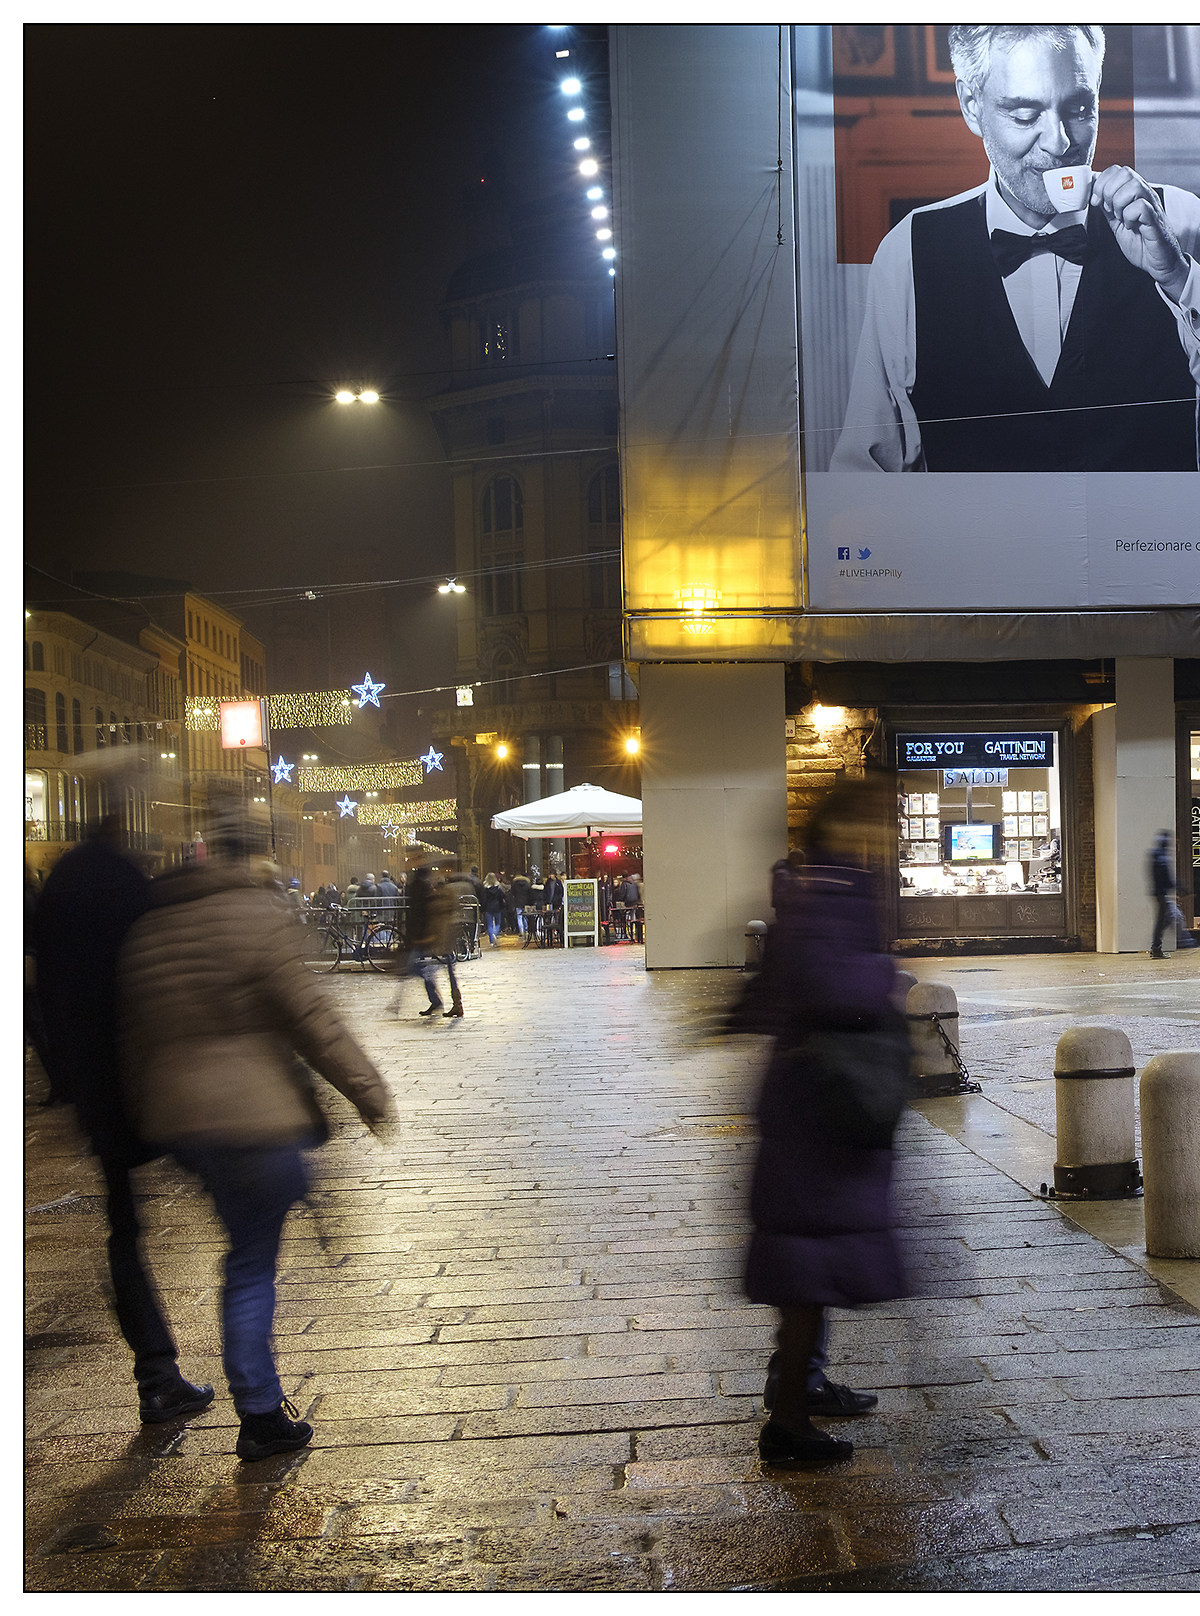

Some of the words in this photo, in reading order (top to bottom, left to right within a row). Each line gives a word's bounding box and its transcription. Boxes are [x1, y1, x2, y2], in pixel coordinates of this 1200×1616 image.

[1114, 538, 1193, 552] Perfezionare
[839, 568, 903, 579] #LIVEHAPPilly
[905, 742, 934, 755] FOR
[935, 741, 965, 755] YOU
[984, 740, 1046, 754] GATTINONI
[1000, 753, 1019, 761] TRAVEL
[1019, 753, 1046, 761] NETWORK
[946, 770, 1004, 786] SALDI
